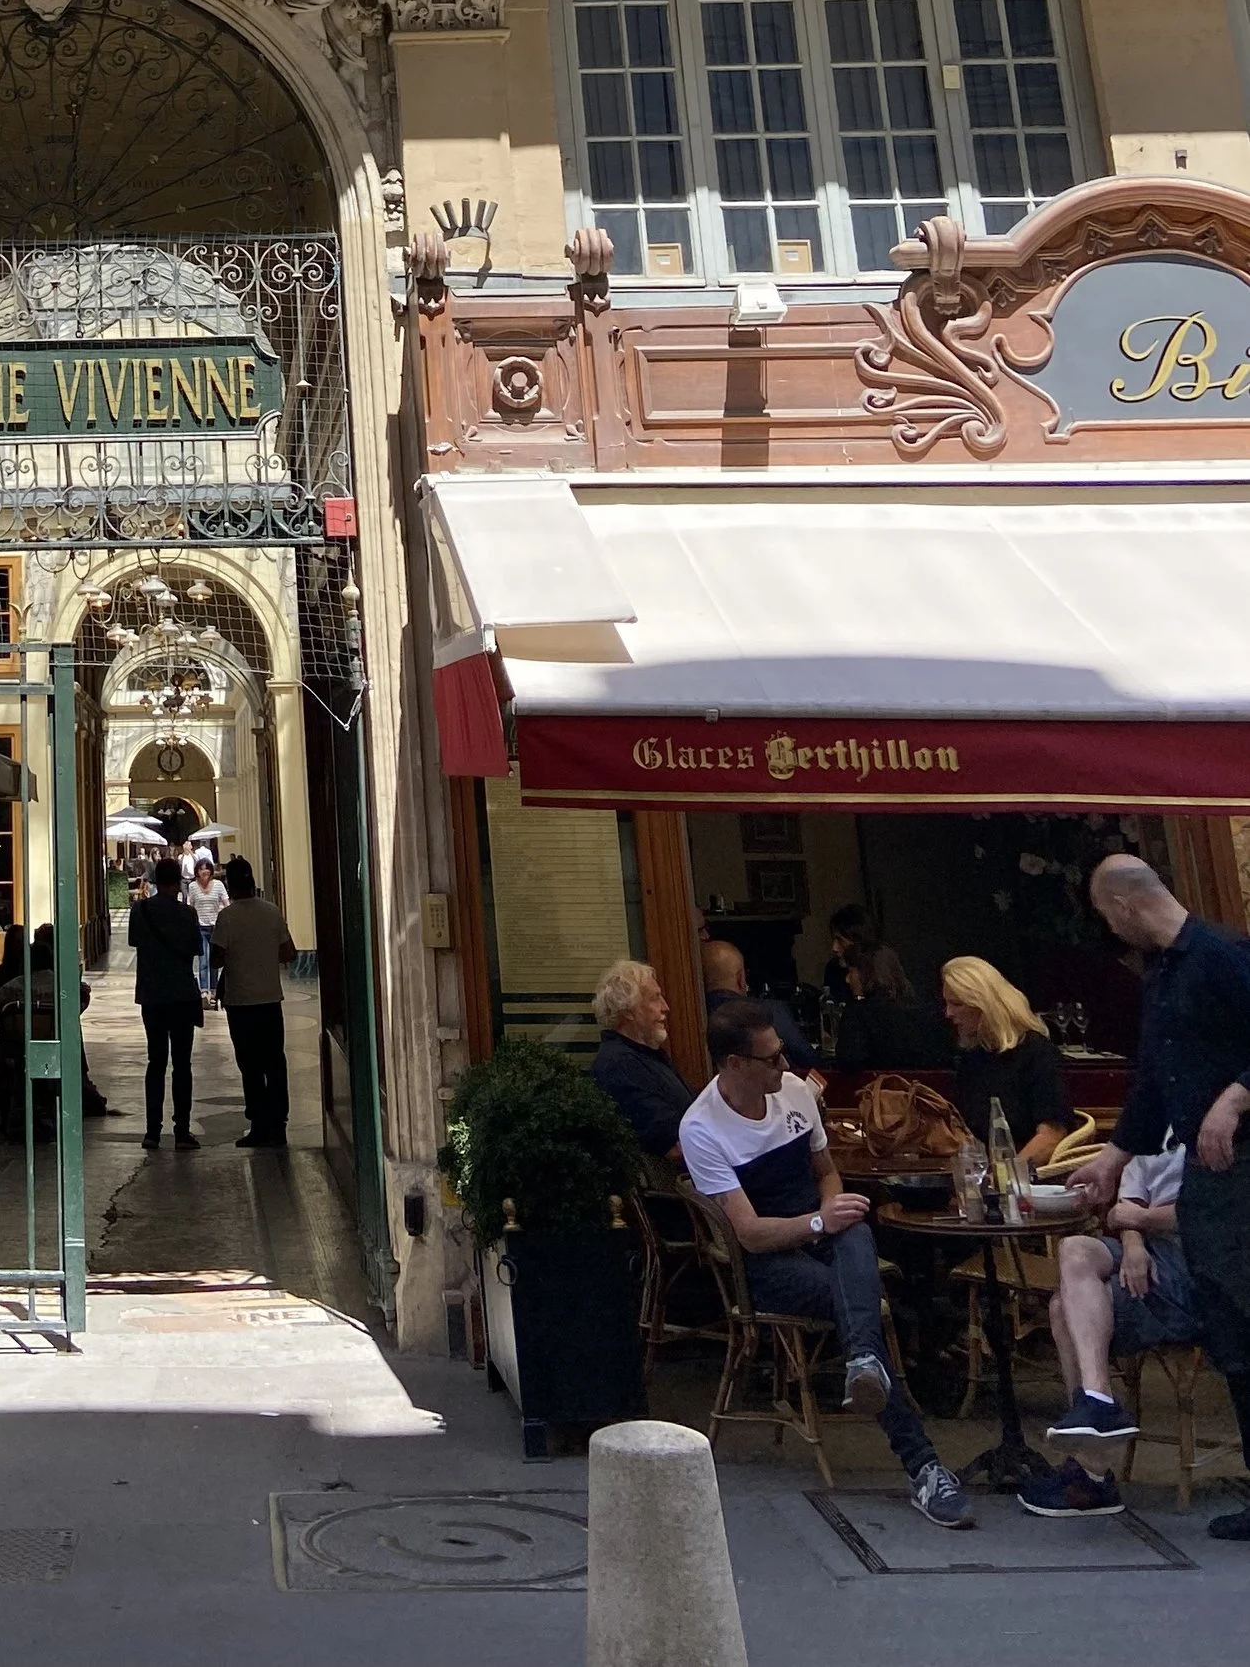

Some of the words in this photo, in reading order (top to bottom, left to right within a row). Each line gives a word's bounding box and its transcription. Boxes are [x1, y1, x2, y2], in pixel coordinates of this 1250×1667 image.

[53, 355, 262, 429] VIVIENNE
[632, 736, 755, 770] Glaces
[764, 729, 961, 782] Berthillon
